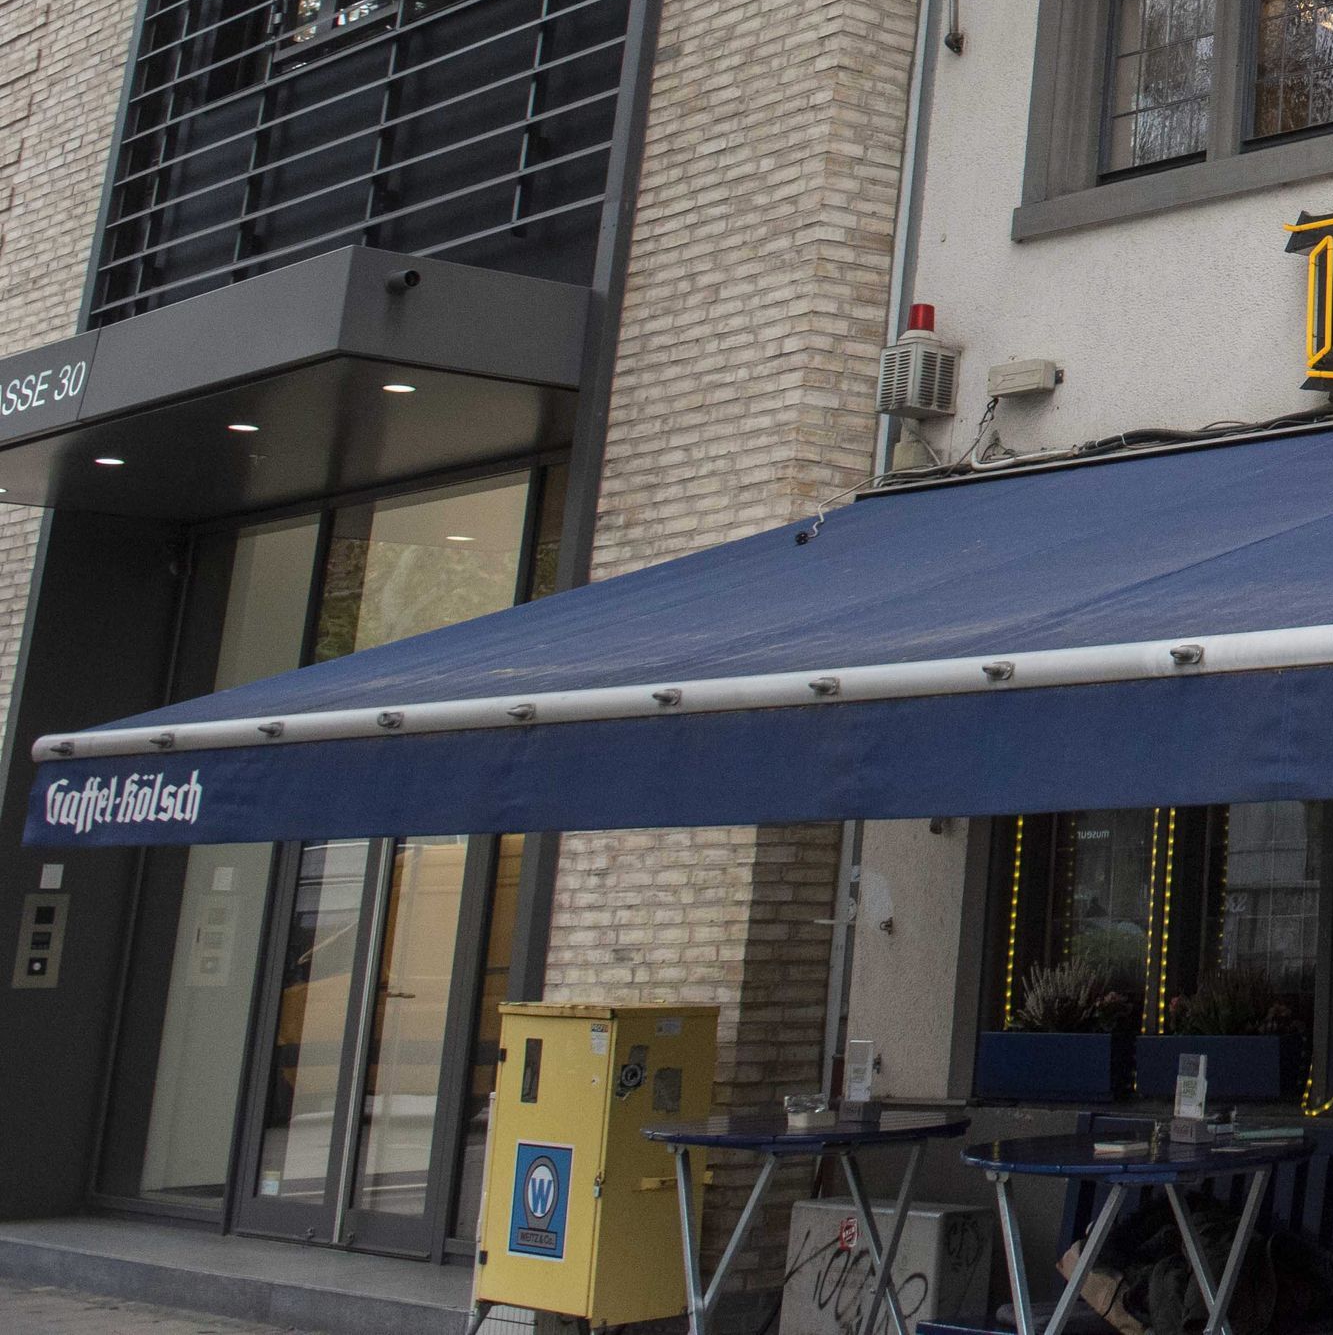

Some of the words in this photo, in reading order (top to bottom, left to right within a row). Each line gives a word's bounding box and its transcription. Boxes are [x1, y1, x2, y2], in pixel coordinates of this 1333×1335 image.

[0, 369, 53, 416] SSE
[54, 361, 87, 401] 30
[531, 1177, 553, 1214] W
